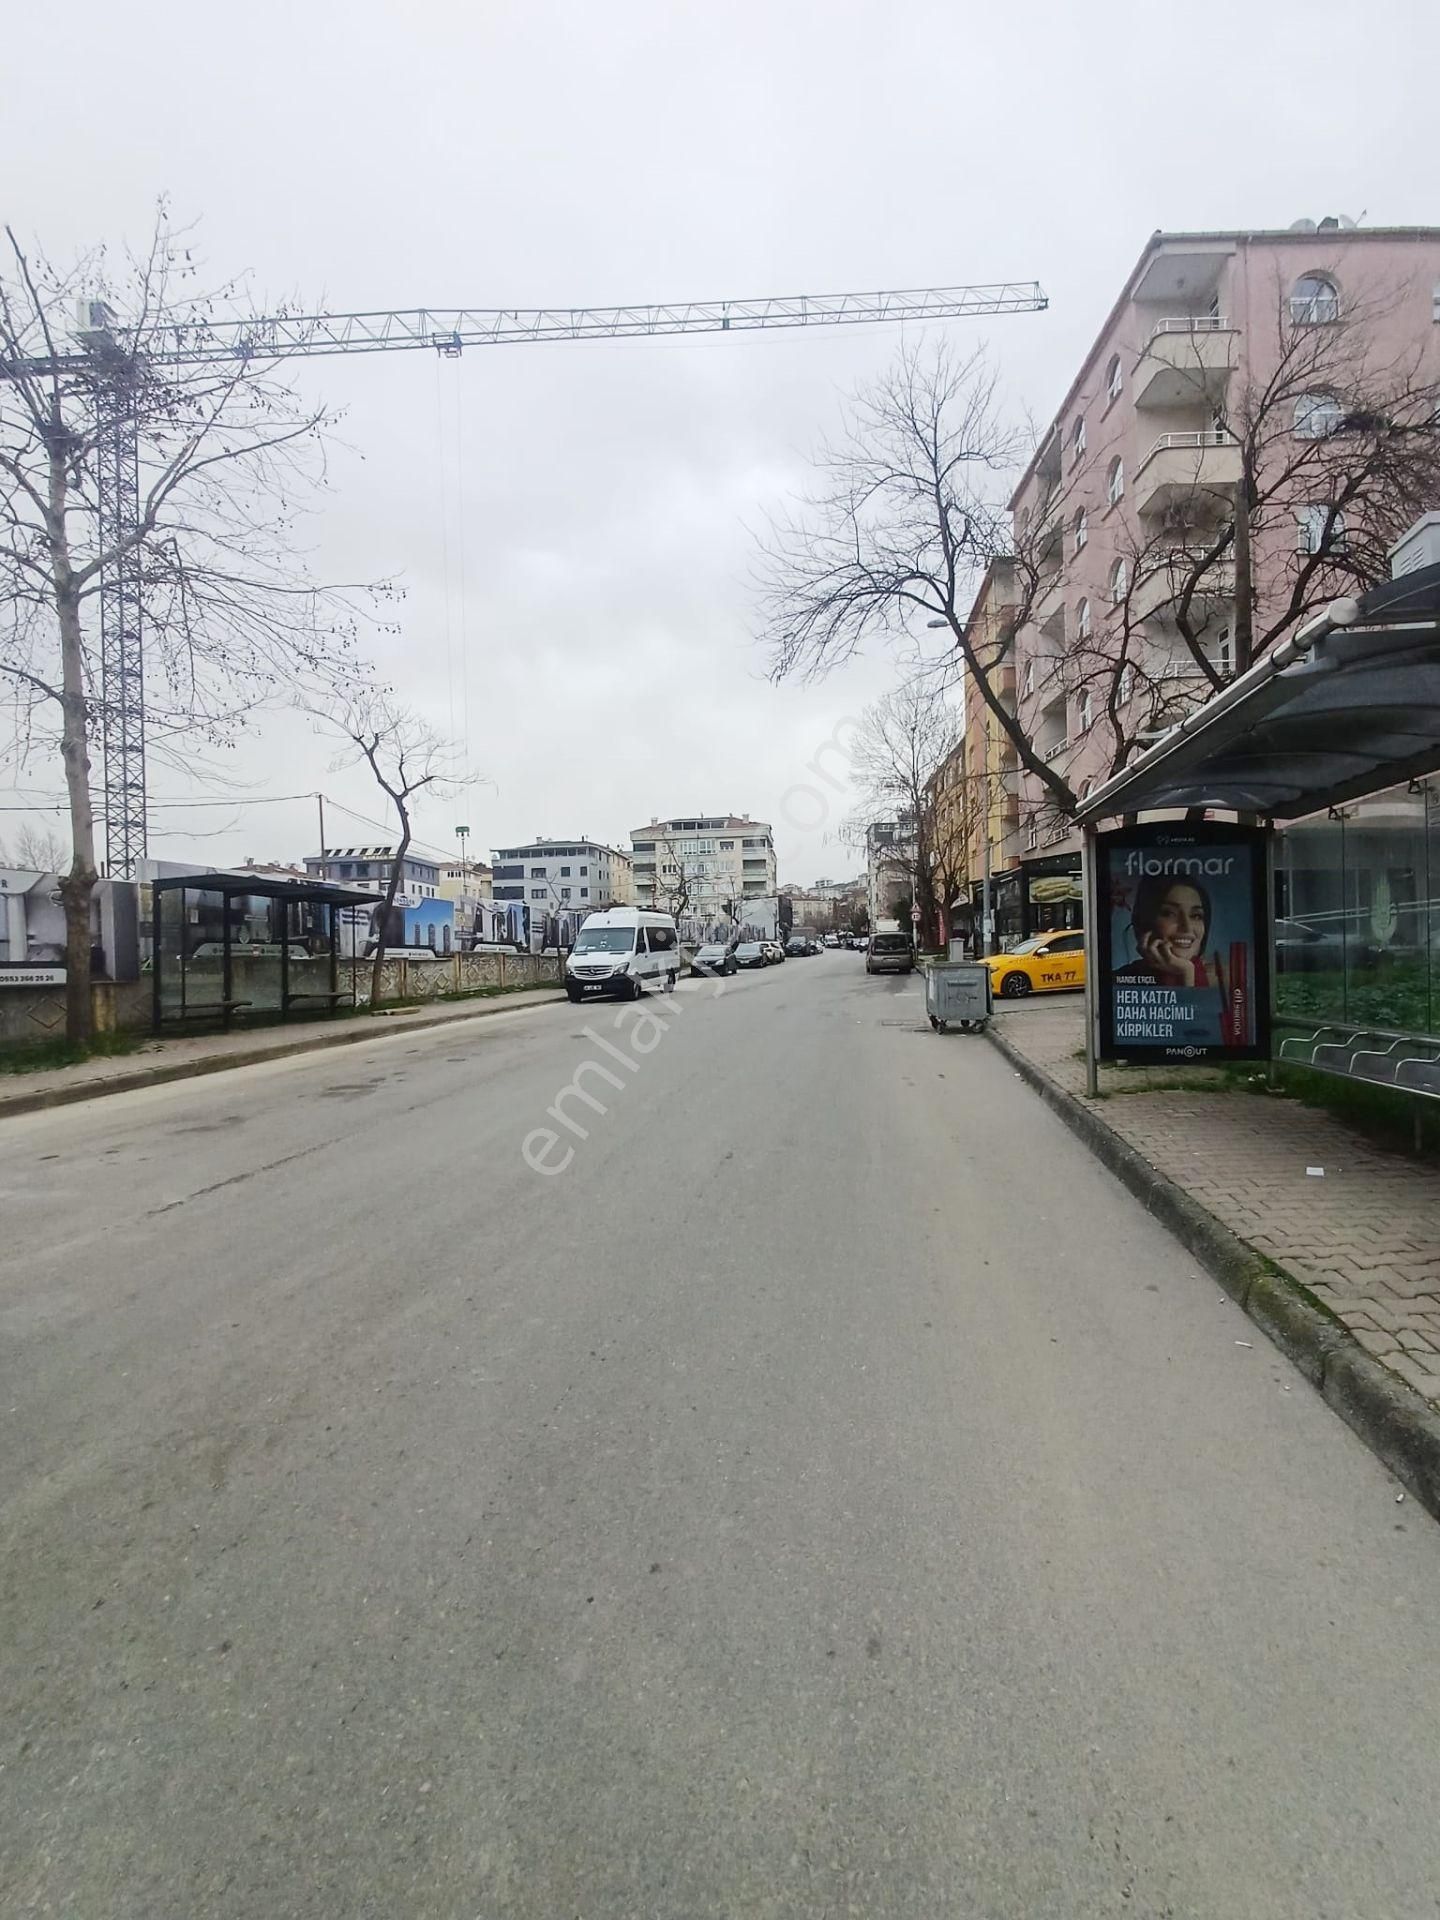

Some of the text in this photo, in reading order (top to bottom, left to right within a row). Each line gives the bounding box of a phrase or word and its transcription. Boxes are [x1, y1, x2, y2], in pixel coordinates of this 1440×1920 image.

[1124, 851, 1234, 876] flormar
[1040, 970, 1076, 982] TKA 77
[1116, 990, 1177, 1004] HER KATTA
[1116, 1004, 1194, 1021] DAHA HACİMLİ
[1116, 1021, 1173, 1037] KİRPİKLER
